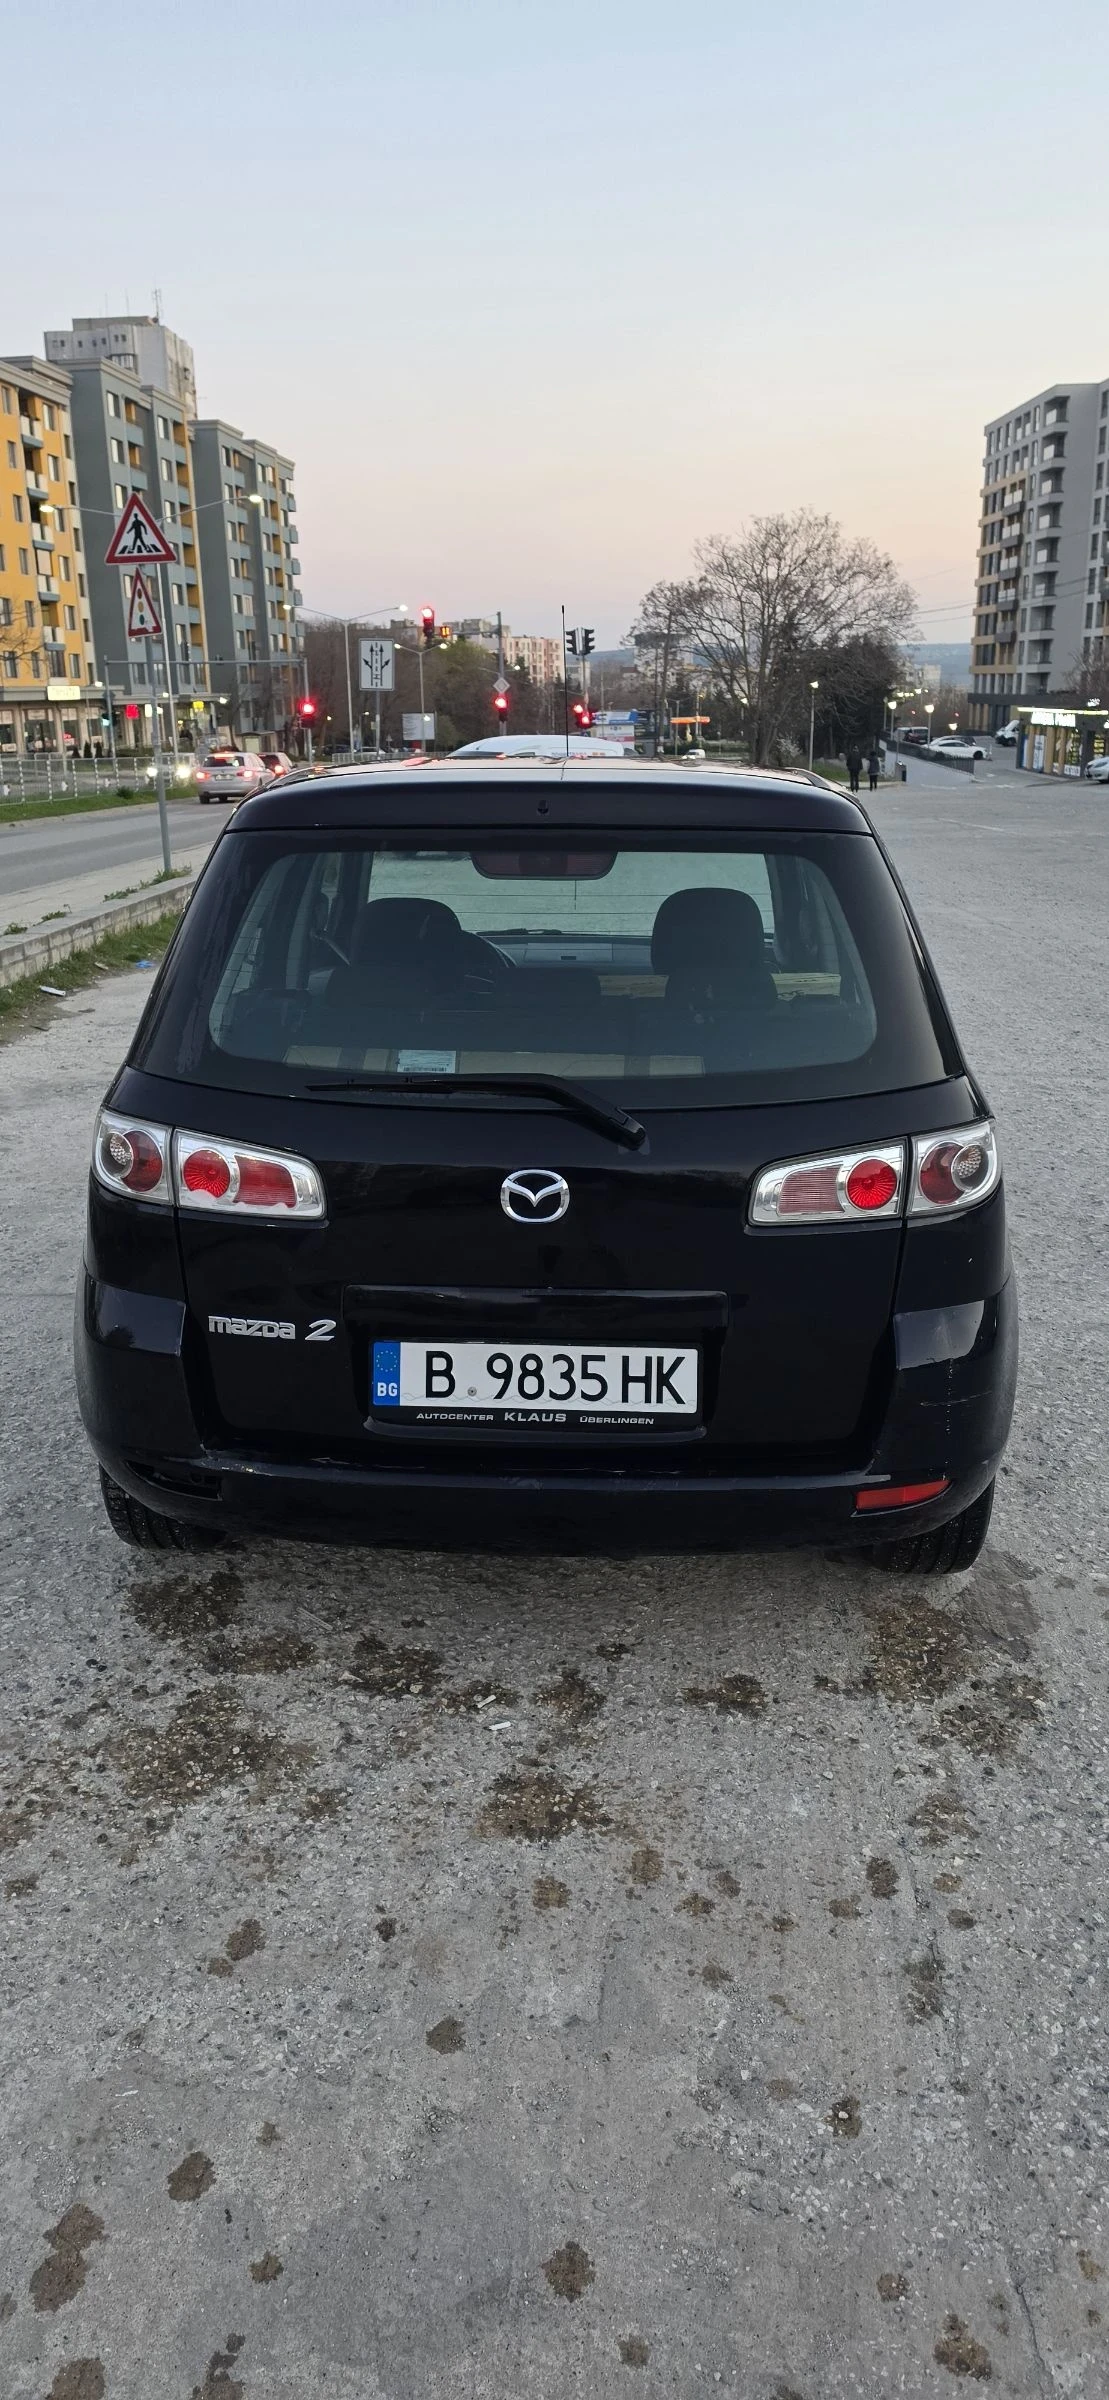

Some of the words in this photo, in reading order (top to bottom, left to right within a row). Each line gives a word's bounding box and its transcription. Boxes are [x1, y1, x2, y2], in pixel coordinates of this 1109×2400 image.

[304, 1319, 337, 1341] 2
[425, 1350, 456, 1398] B
[486, 1352, 609, 1402] 9835
[621, 1355, 686, 1405] HK
[377, 1382, 398, 1397] BG
[416, 1412, 494, 1421] AUTOCENTER
[504, 1411, 567, 1423] KLAUS
[579, 1415, 654, 1425] ÜBERLINGEN
